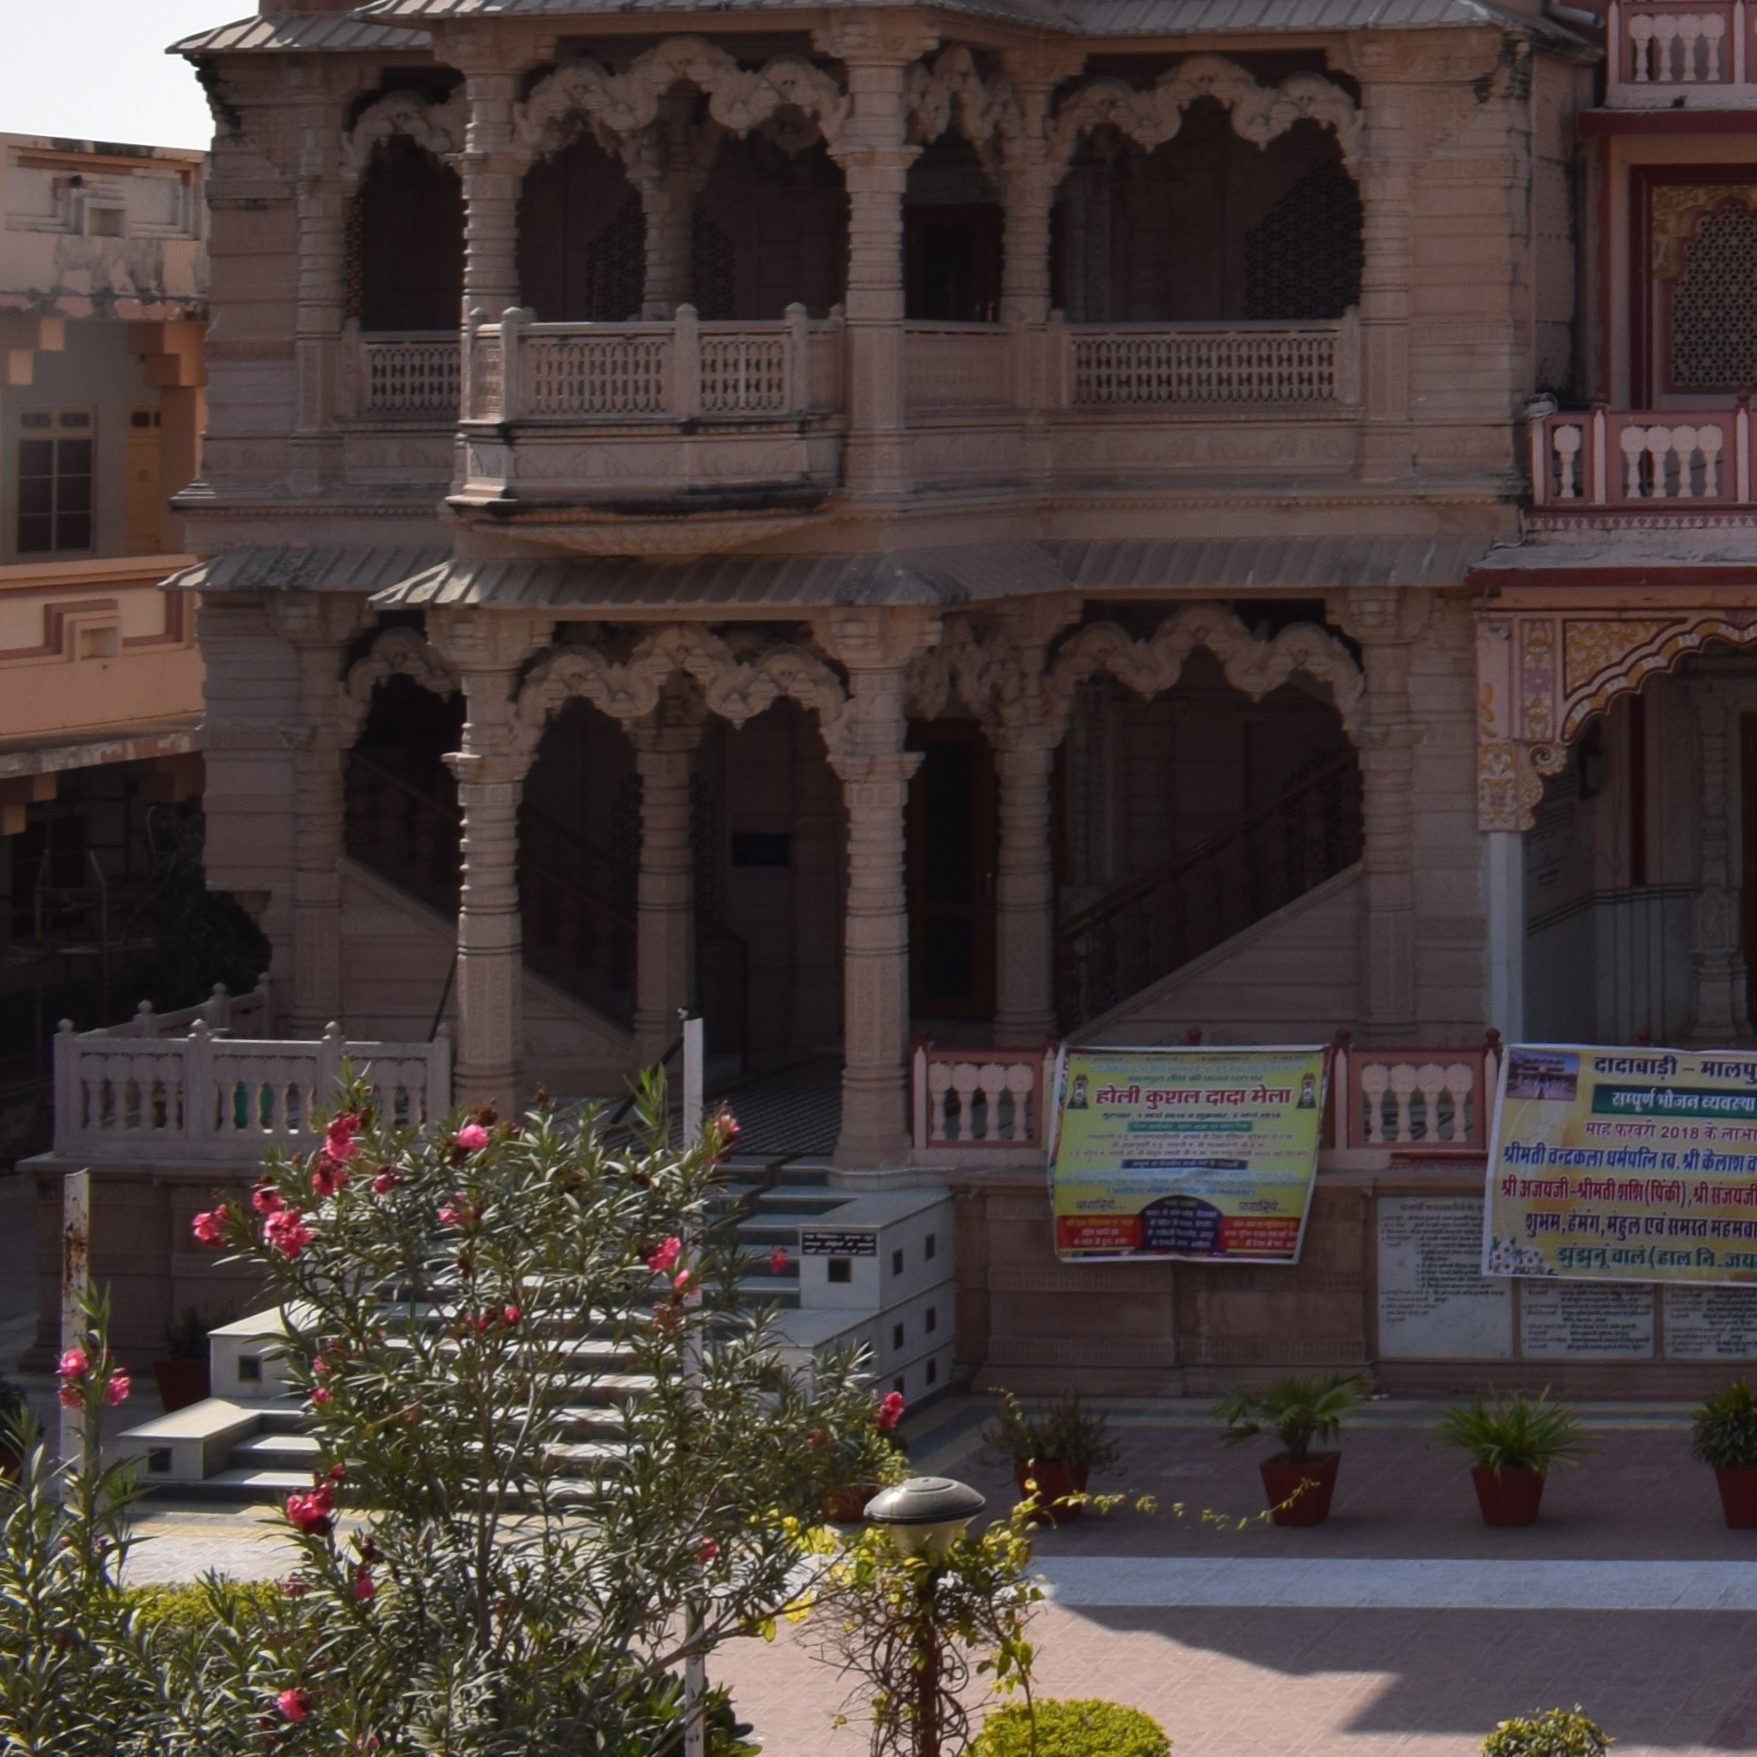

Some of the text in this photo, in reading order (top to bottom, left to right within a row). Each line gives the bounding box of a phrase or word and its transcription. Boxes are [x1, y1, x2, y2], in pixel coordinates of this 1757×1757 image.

[1096, 1084, 1292, 1110] होली कुशल दादा मेला
[1612, 1088, 1655, 1113] सम्पूर्ण
[1701, 1096, 1756, 1113] व्यवस्था
[1585, 1122, 1610, 1136] माह
[1614, 1119, 1656, 1138] फरवरी
[1661, 1126, 1699, 1140] 2018
[1705, 1122, 1717, 1140] के
[1503, 1141, 1546, 1165] श्रीमती
[1660, 1152, 1680, 1170] स्व.
[1683, 1148, 1700, 1171] श्री
[1702, 1148, 1744, 1173] कैलाश
[1502, 1174, 1517, 1198] श्री
[1693, 1181, 1708, 1206] श्री
[1644, 1211, 1666, 1235] एवं
[1669, 1217, 1707, 1237] समस्त
[1612, 1245, 1647, 1264] वाले
